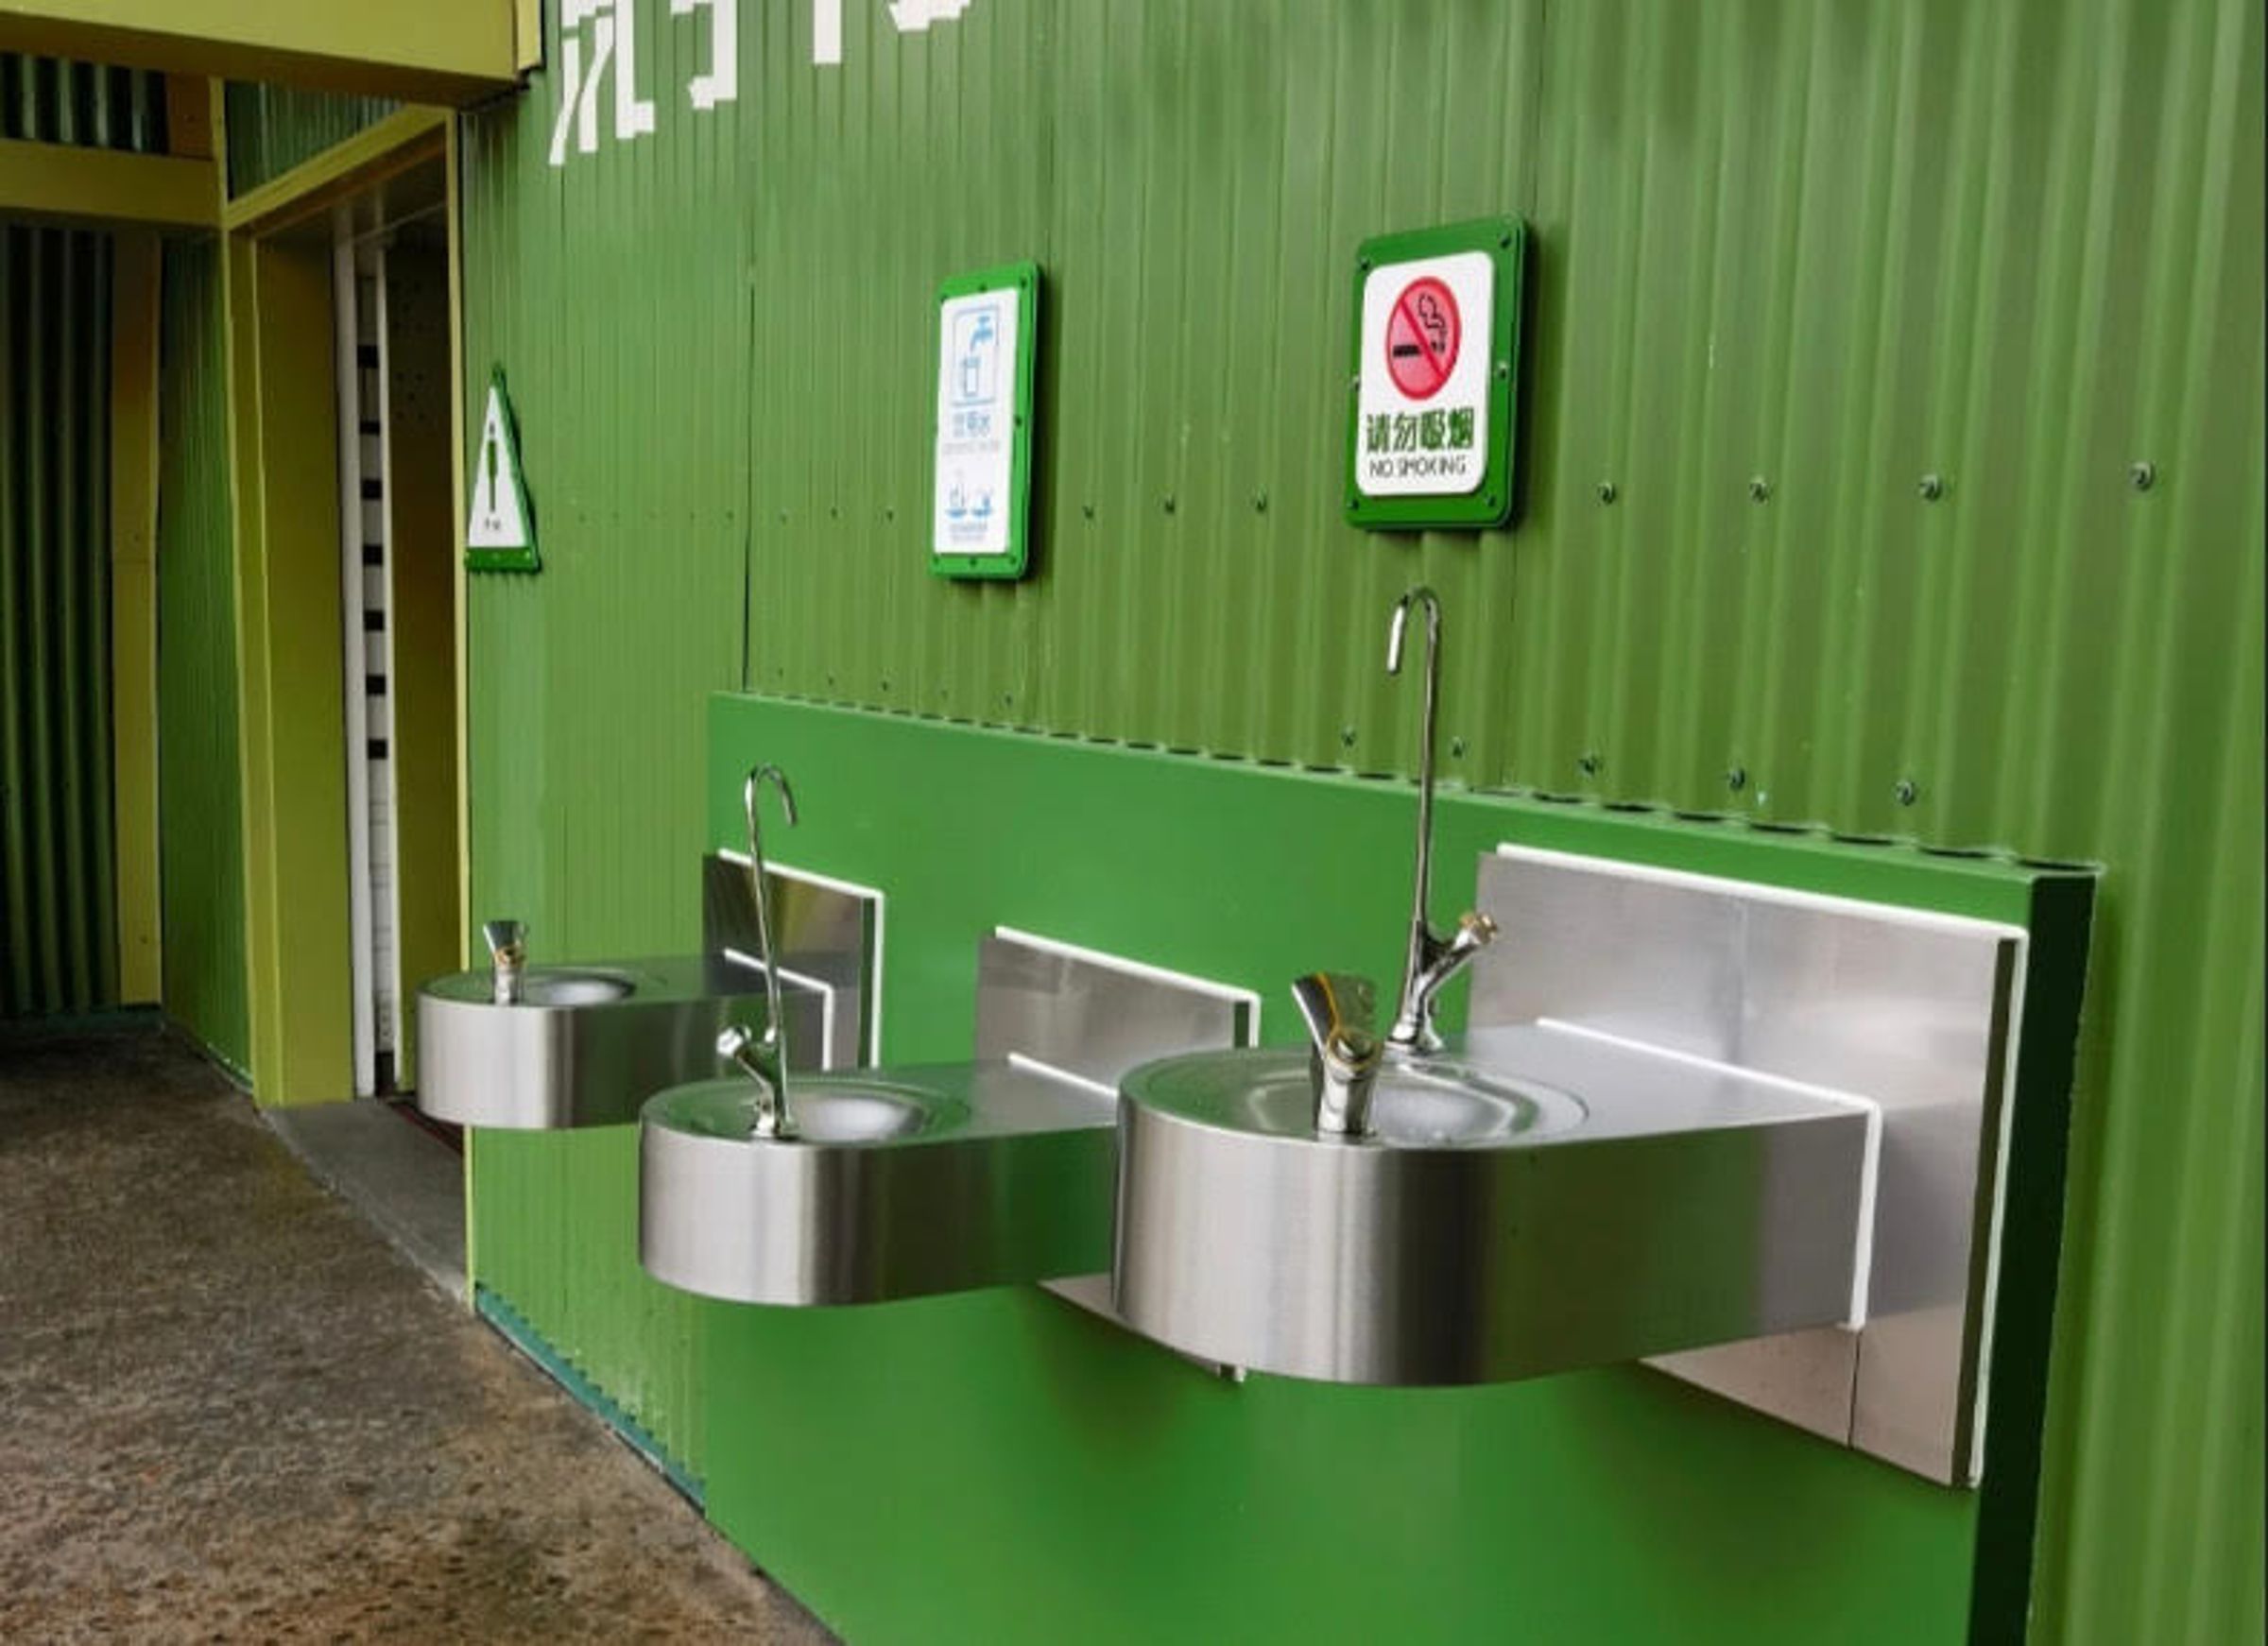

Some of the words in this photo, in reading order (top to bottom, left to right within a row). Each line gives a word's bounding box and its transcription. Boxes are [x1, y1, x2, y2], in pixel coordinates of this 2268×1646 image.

[1366, 407, 1474, 453] 请勿吸烟
[1369, 457, 1394, 478] NO
[1398, 454, 1467, 477] SMOKING
